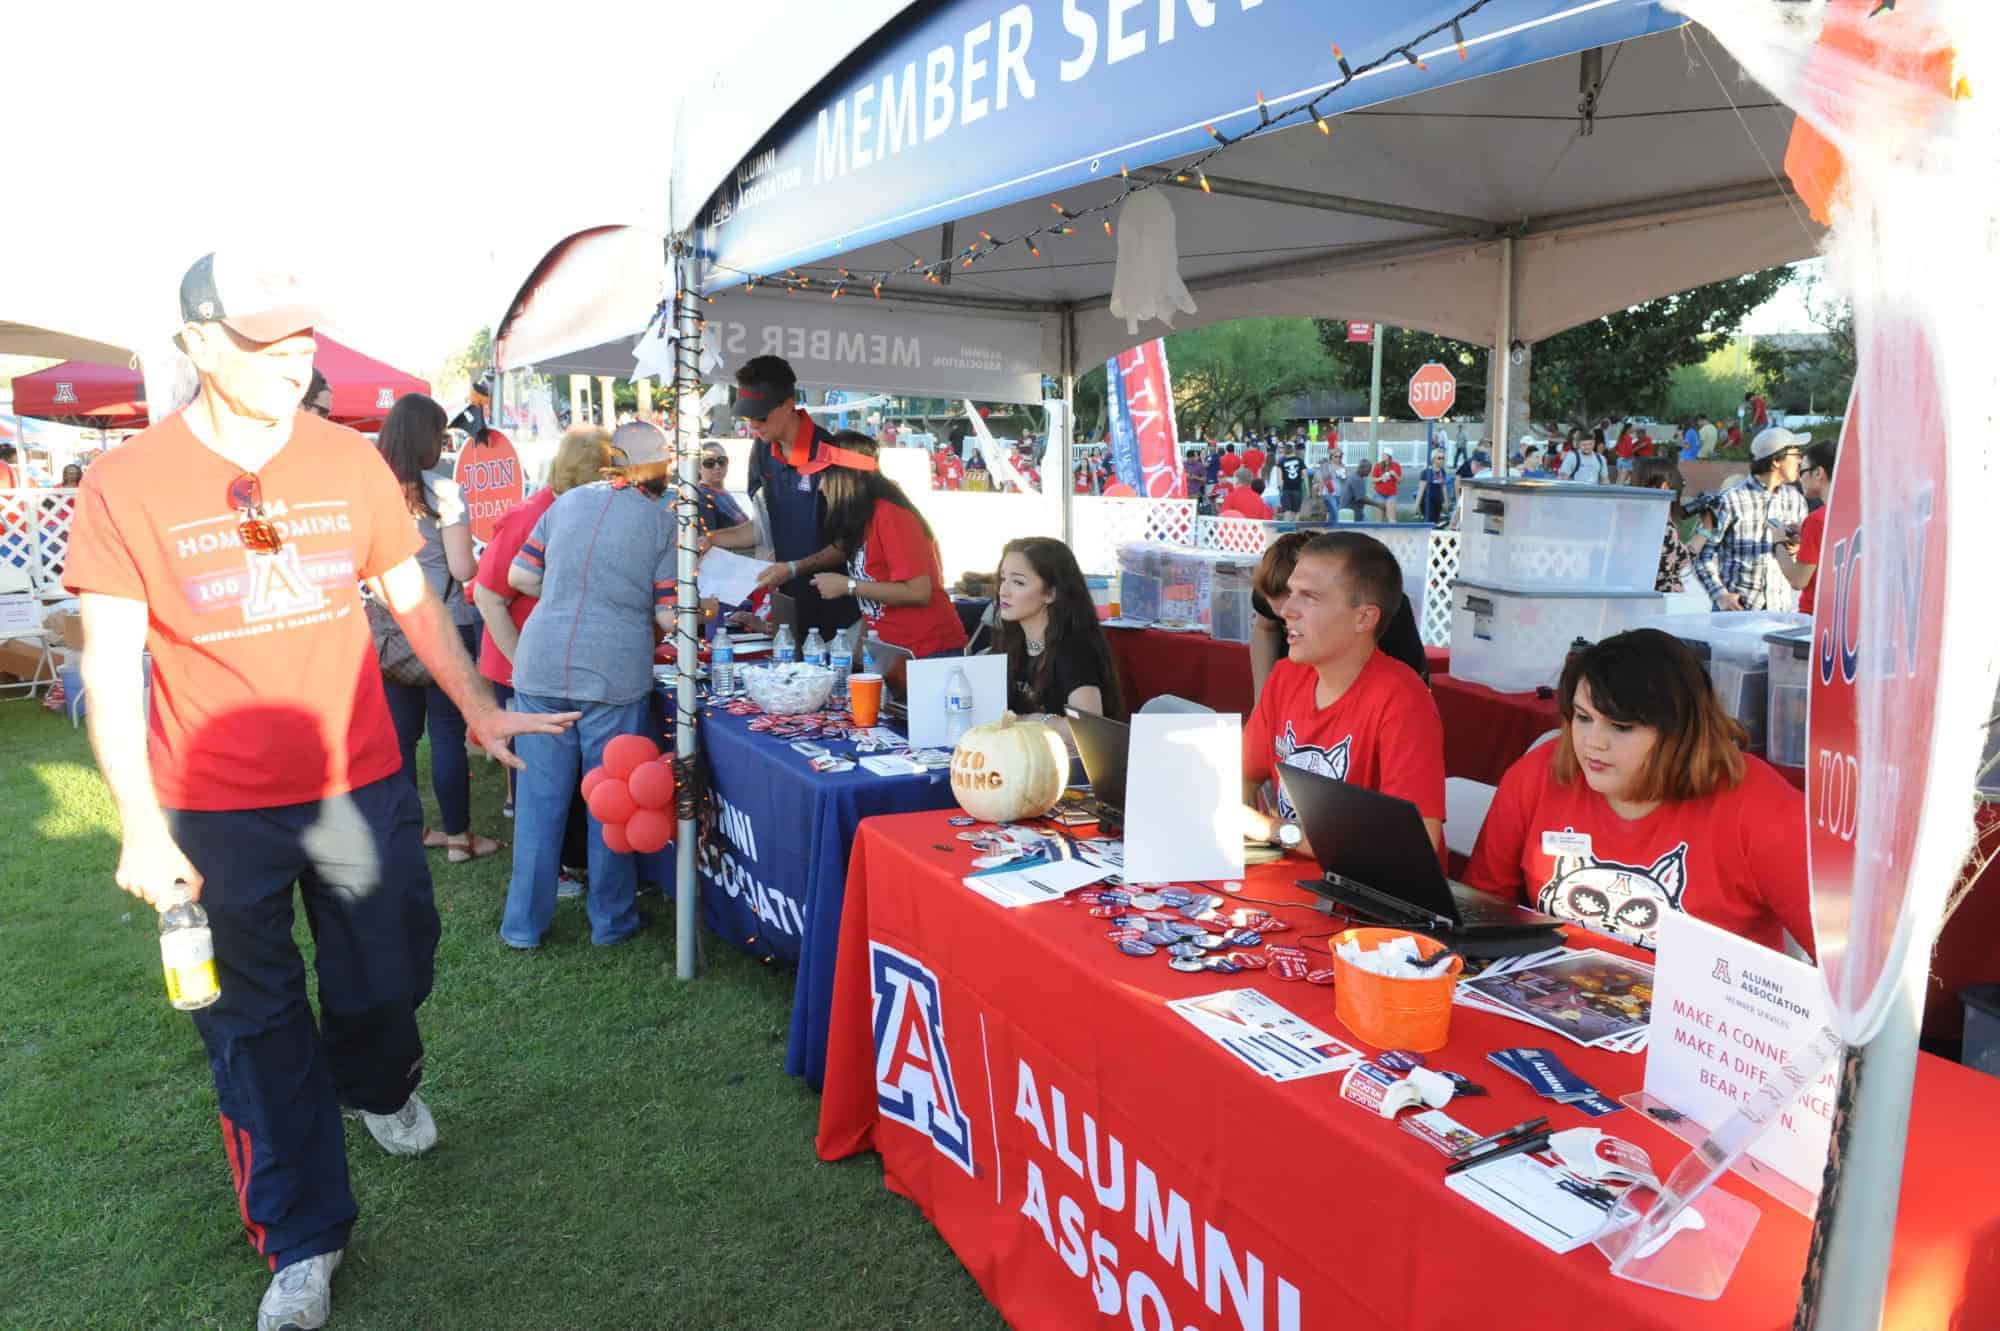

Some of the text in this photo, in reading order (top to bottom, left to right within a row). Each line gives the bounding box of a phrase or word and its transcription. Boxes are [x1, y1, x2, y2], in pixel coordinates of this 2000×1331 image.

[812, 4, 1036, 186] MEMBER
[736, 147, 777, 185] ALUMNI
[1413, 381, 1452, 402] STOP
[463, 457, 515, 493] JOIN
[199, 578, 240, 601] 100
[240, 542, 326, 624] A
[1740, 982, 1811, 1019] ASSOCIATION
[1742, 970, 1783, 994] ALUMNI
[1672, 1000, 1713, 1029] MAKE
[1718, 1021, 1728, 1036] A
[868, 939, 975, 1179] A
[1674, 1028, 1714, 1059] MAKE
[1719, 1051, 1729, 1066] A
[1532, 1061, 1567, 1093] ALUMNI
[1700, 1069, 1738, 1100] BEAR
[1014, 1058, 1301, 1331] ALUMNI
[1020, 1159, 1200, 1331] ASSO
